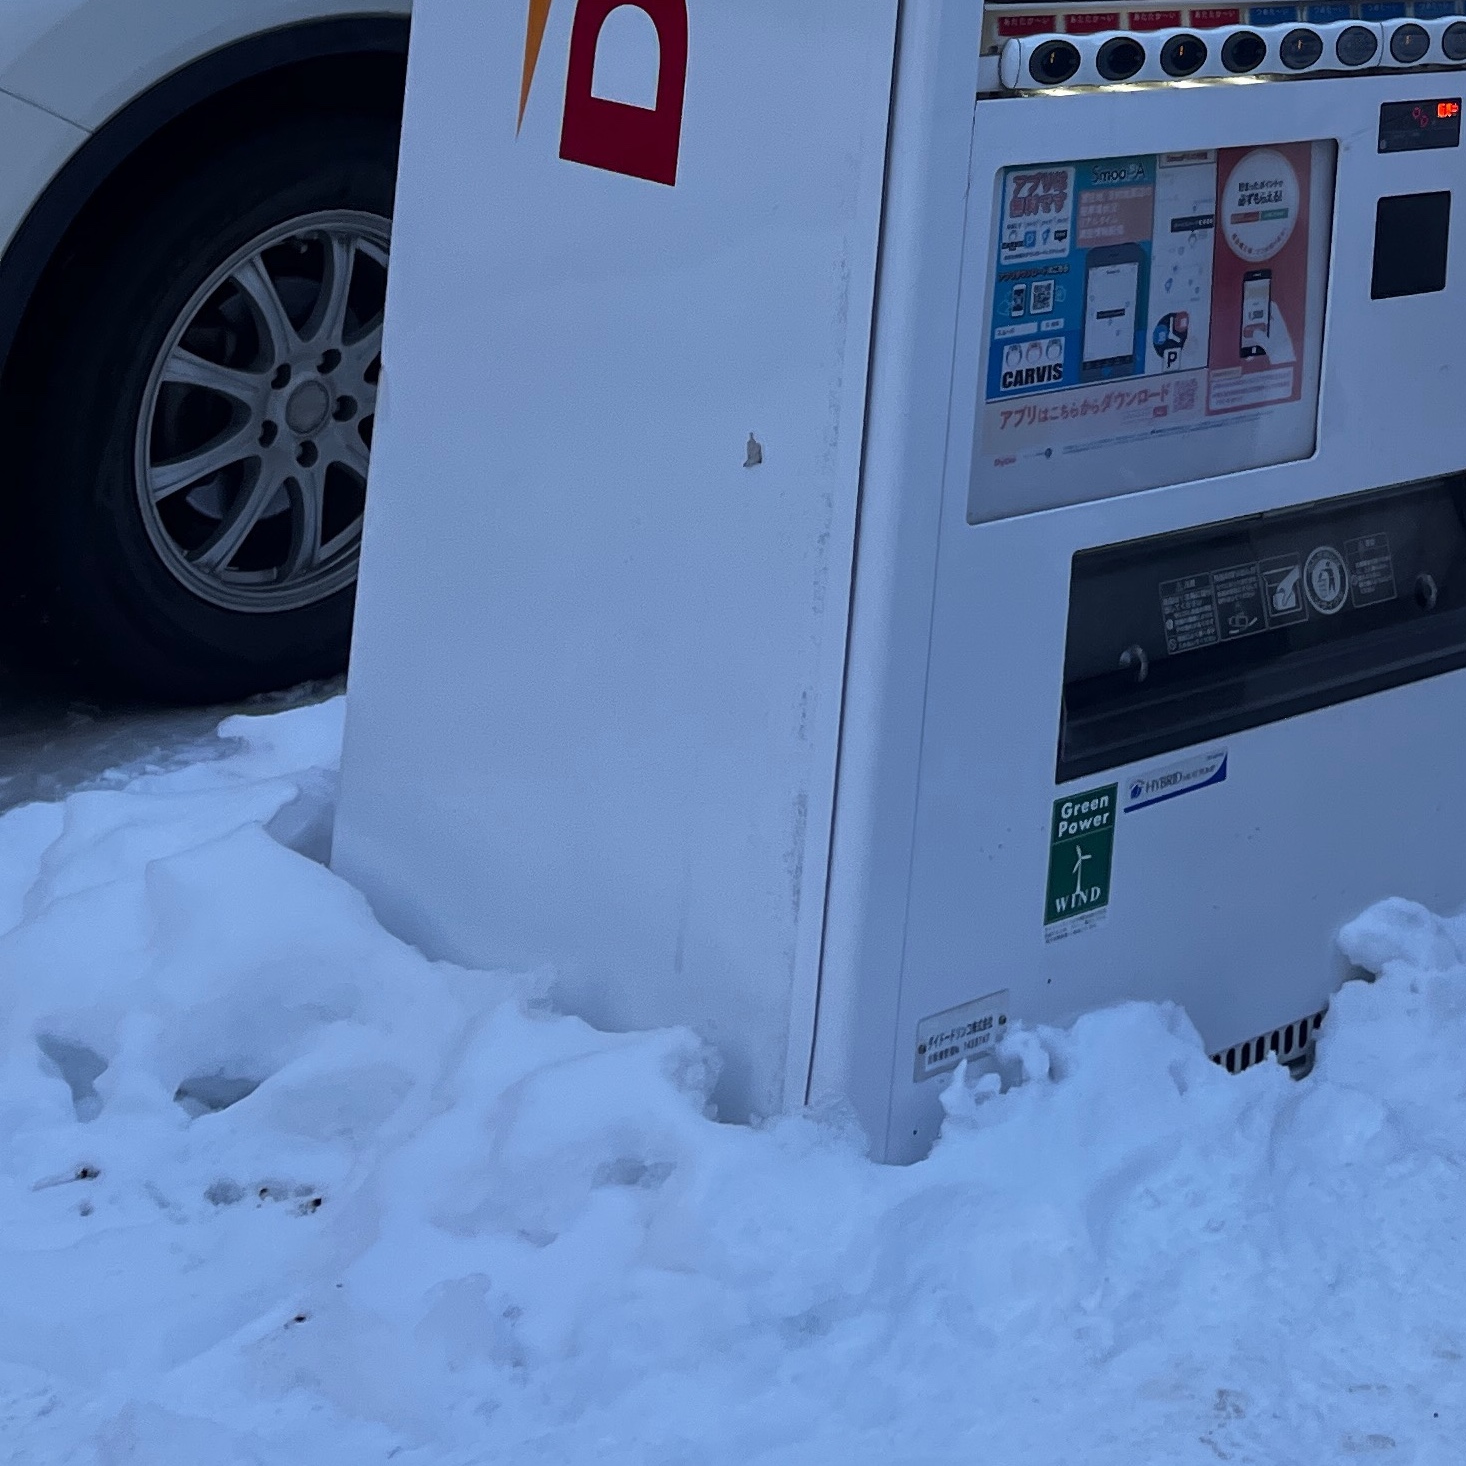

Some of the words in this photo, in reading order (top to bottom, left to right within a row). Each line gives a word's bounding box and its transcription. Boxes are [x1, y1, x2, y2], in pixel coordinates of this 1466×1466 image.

[1002, 362, 1064, 390] CARVIS
[1060, 795, 1110, 820] Green
[1057, 812, 1110, 838] Power
[1054, 886, 1101, 914] WIND
